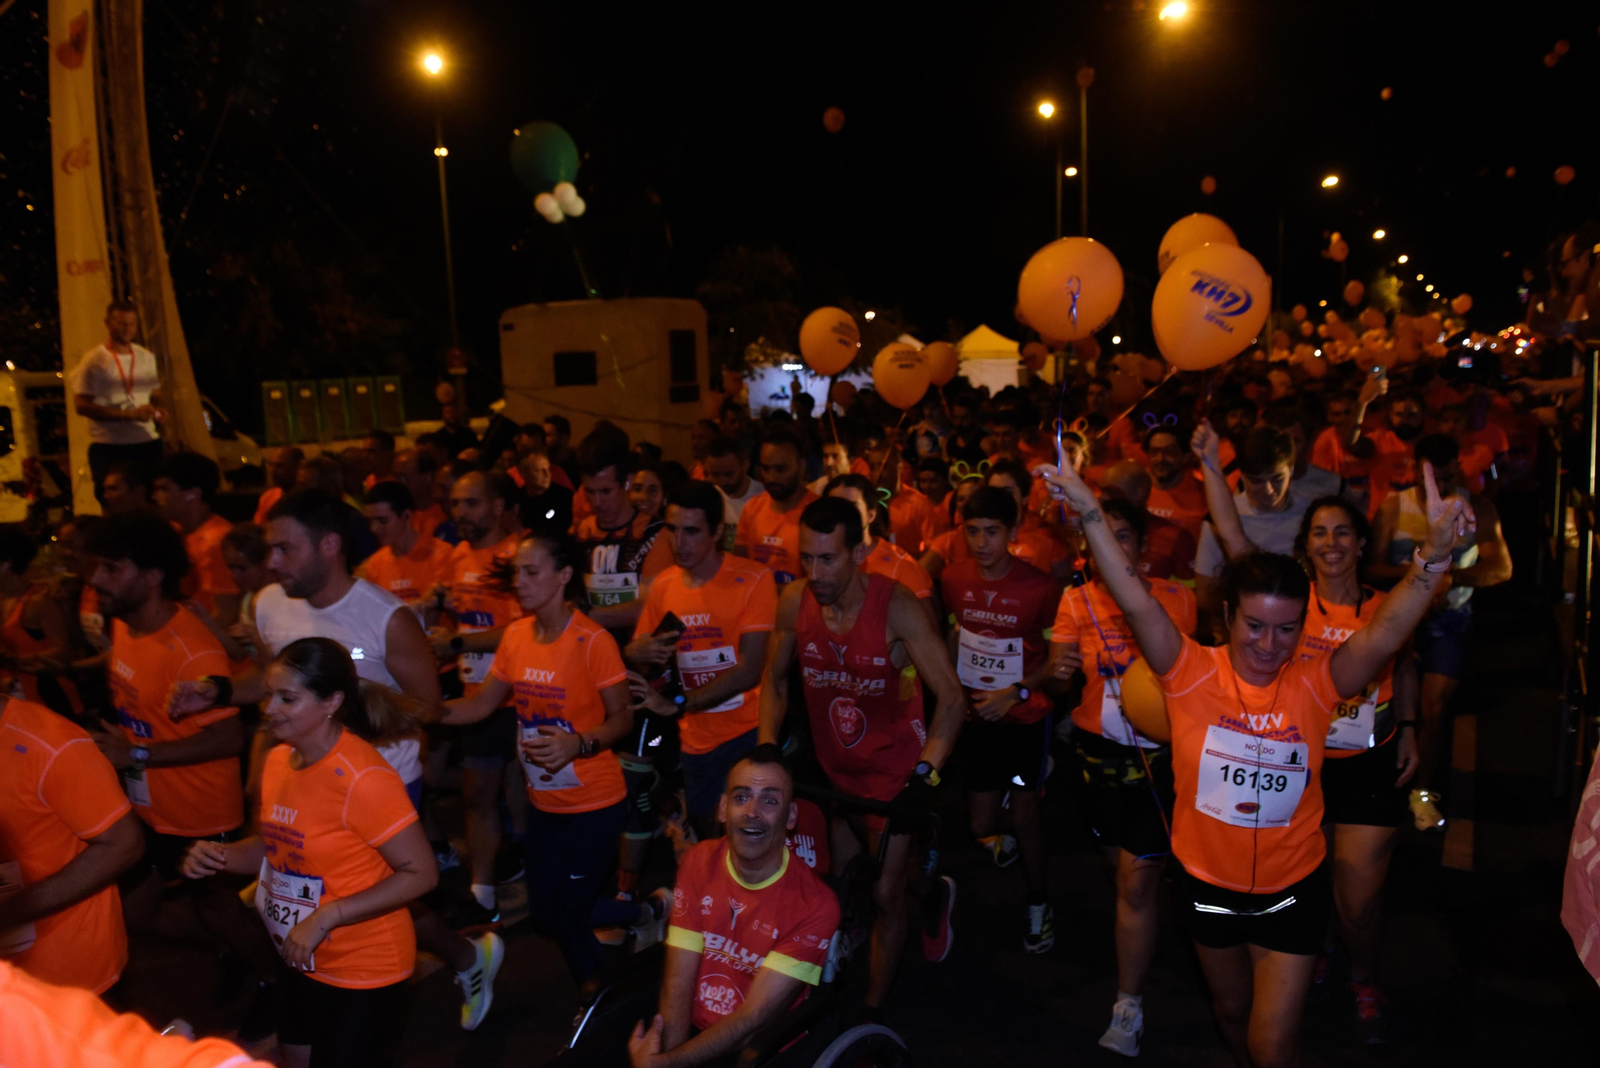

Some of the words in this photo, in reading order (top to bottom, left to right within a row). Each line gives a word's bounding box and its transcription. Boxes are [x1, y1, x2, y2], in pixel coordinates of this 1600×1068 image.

[1190, 279, 1241, 309] KH7
[597, 593, 621, 605] 764
[971, 654, 1005, 671] 8274
[524, 667, 556, 684] XXXV
[1220, 764, 1287, 793] 16139
[271, 803, 298, 825] XXXV
